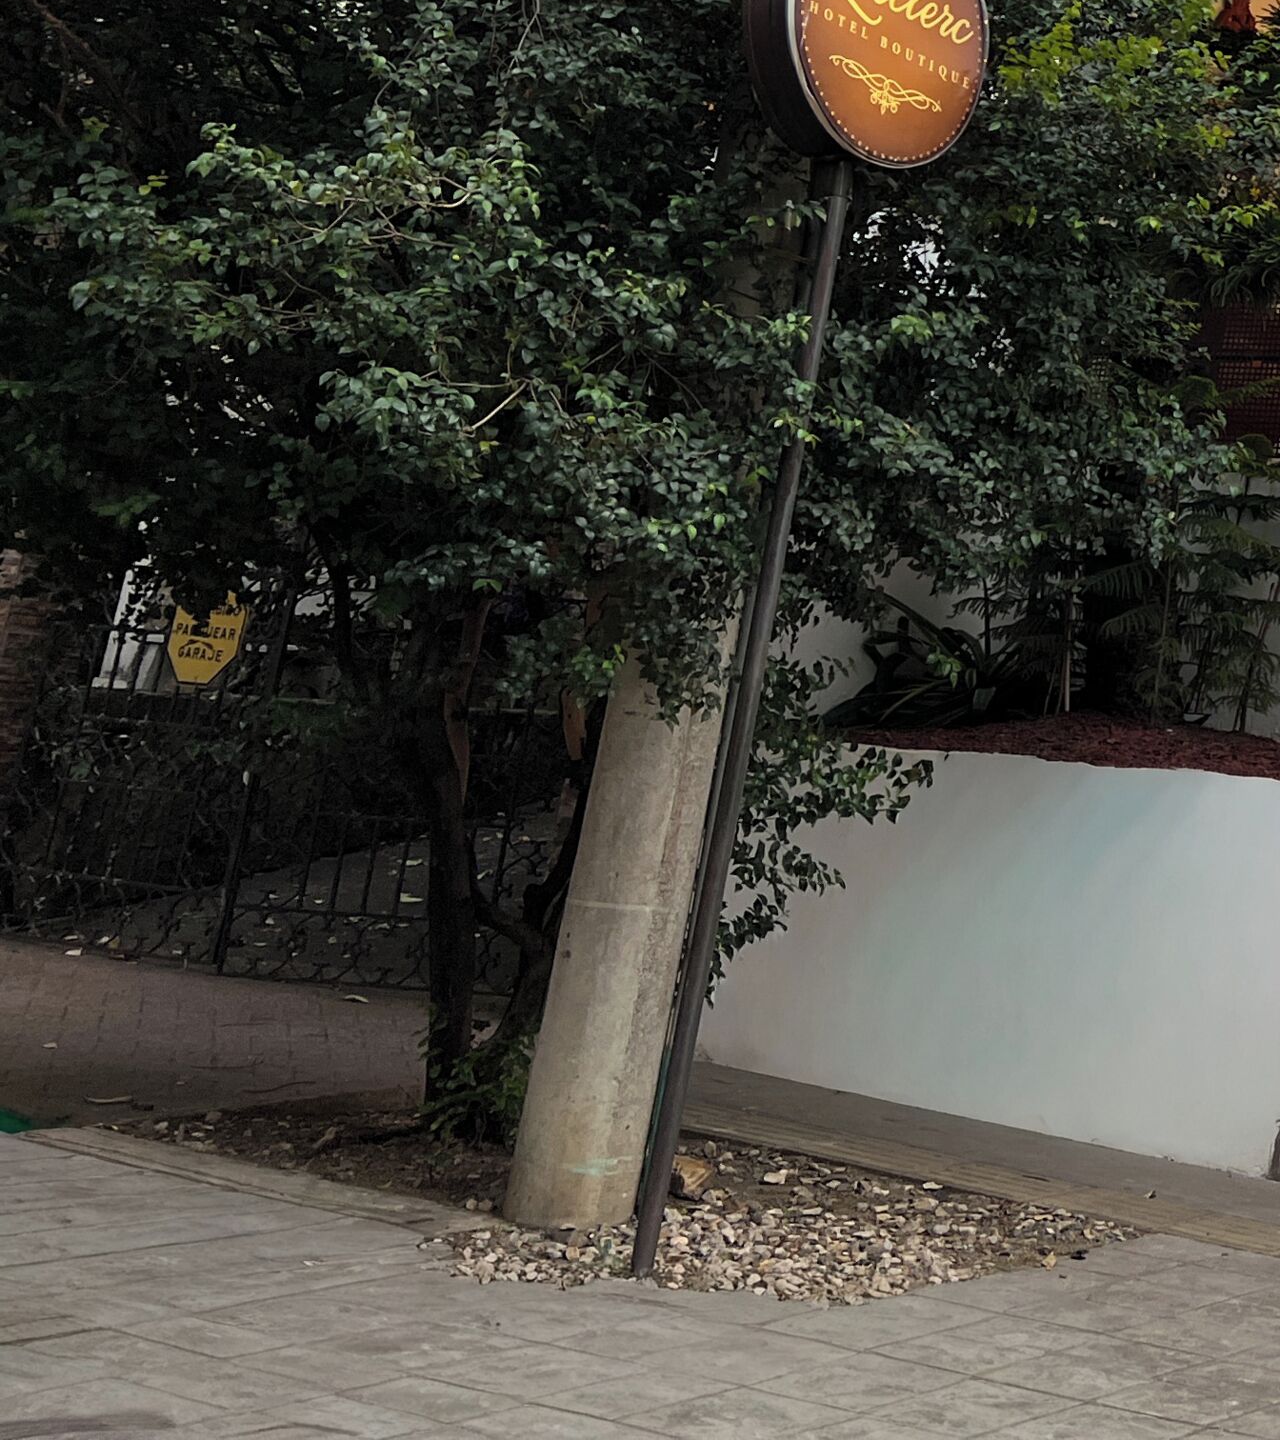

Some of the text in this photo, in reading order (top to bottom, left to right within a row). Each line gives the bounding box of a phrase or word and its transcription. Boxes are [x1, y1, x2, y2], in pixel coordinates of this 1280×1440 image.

[809, 0, 971, 90] HOTEL BOUTIQUE
[176, 622, 236, 641] PAUEAR
[178, 646, 223, 662] GARAJE
